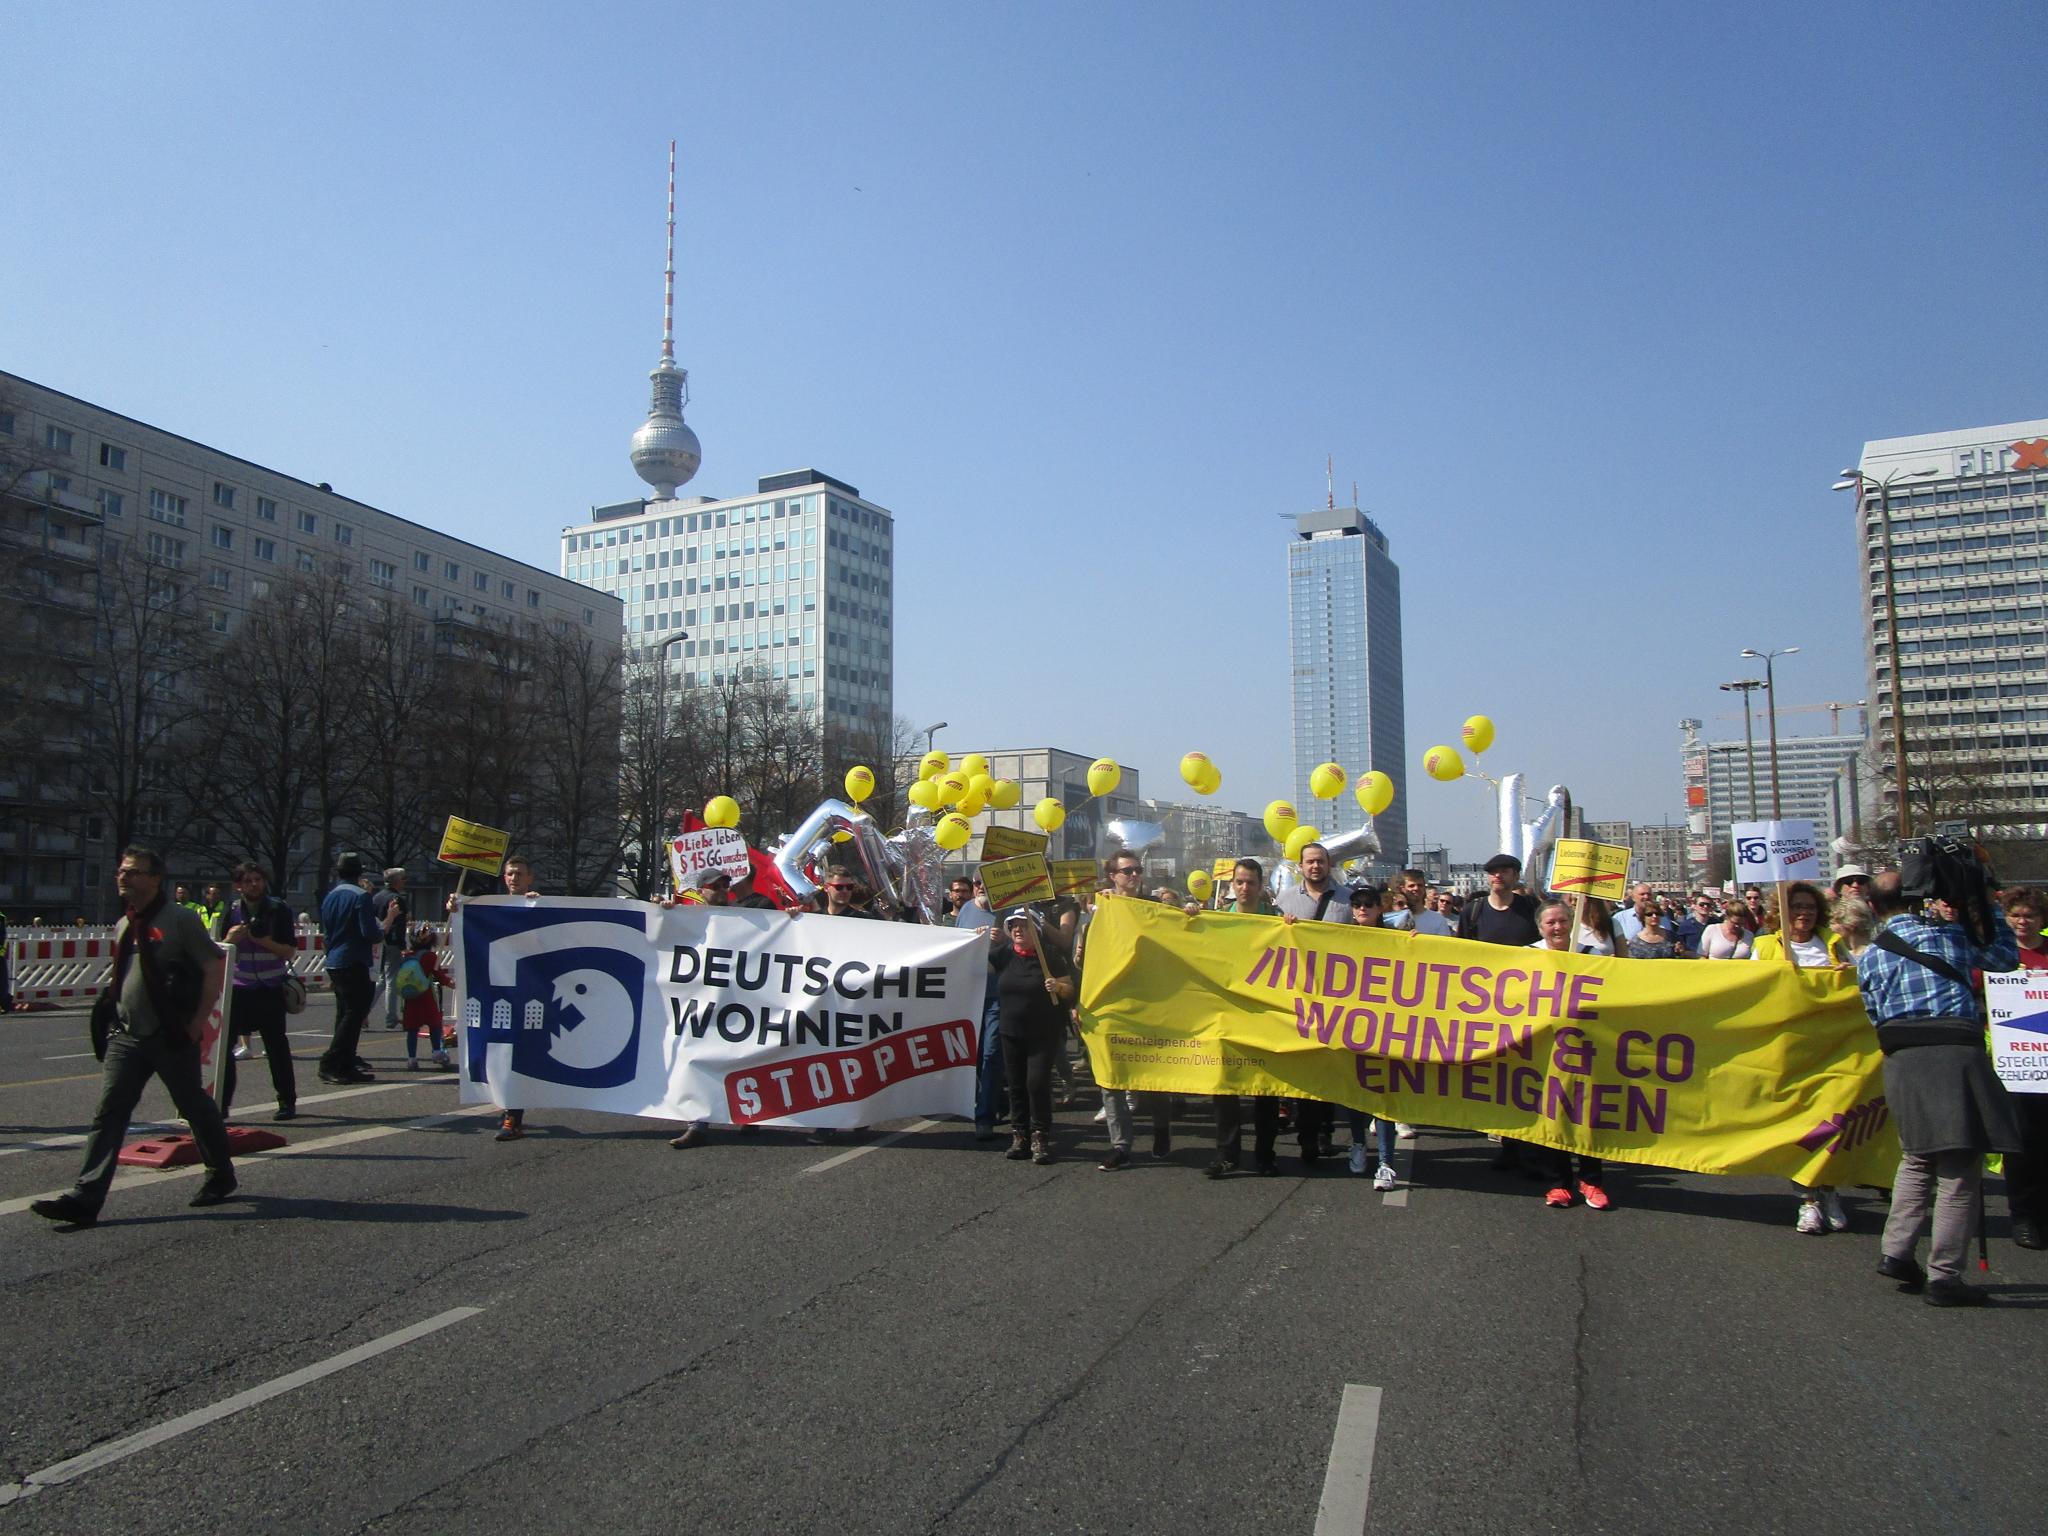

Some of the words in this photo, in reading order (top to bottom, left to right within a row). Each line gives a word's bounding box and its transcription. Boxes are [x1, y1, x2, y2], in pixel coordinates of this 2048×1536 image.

[685, 834, 713, 851] Liebe
[716, 829, 741, 845] leben
[1770, 839, 1809, 847] DEUTSCHE
[670, 945, 947, 1000] DEUTSCHE
[1322, 952, 1604, 1020] DEUTSCHE
[1988, 976, 2029, 985] keine
[670, 997, 903, 1047] WOHNEN
[1991, 1008, 2012, 1018] für
[1110, 1034, 1201, 1049] dwenteignen.de
[1295, 997, 1532, 1065] WOHNEN
[1553, 1027, 1596, 1076] &
[1616, 1030, 1695, 1083] CO
[736, 1026, 971, 1119] STOPPEN
[1110, 1051, 1265, 1069] facebook.com/DWenteignen
[1355, 1055, 1668, 1135] ENTEIGNEN
